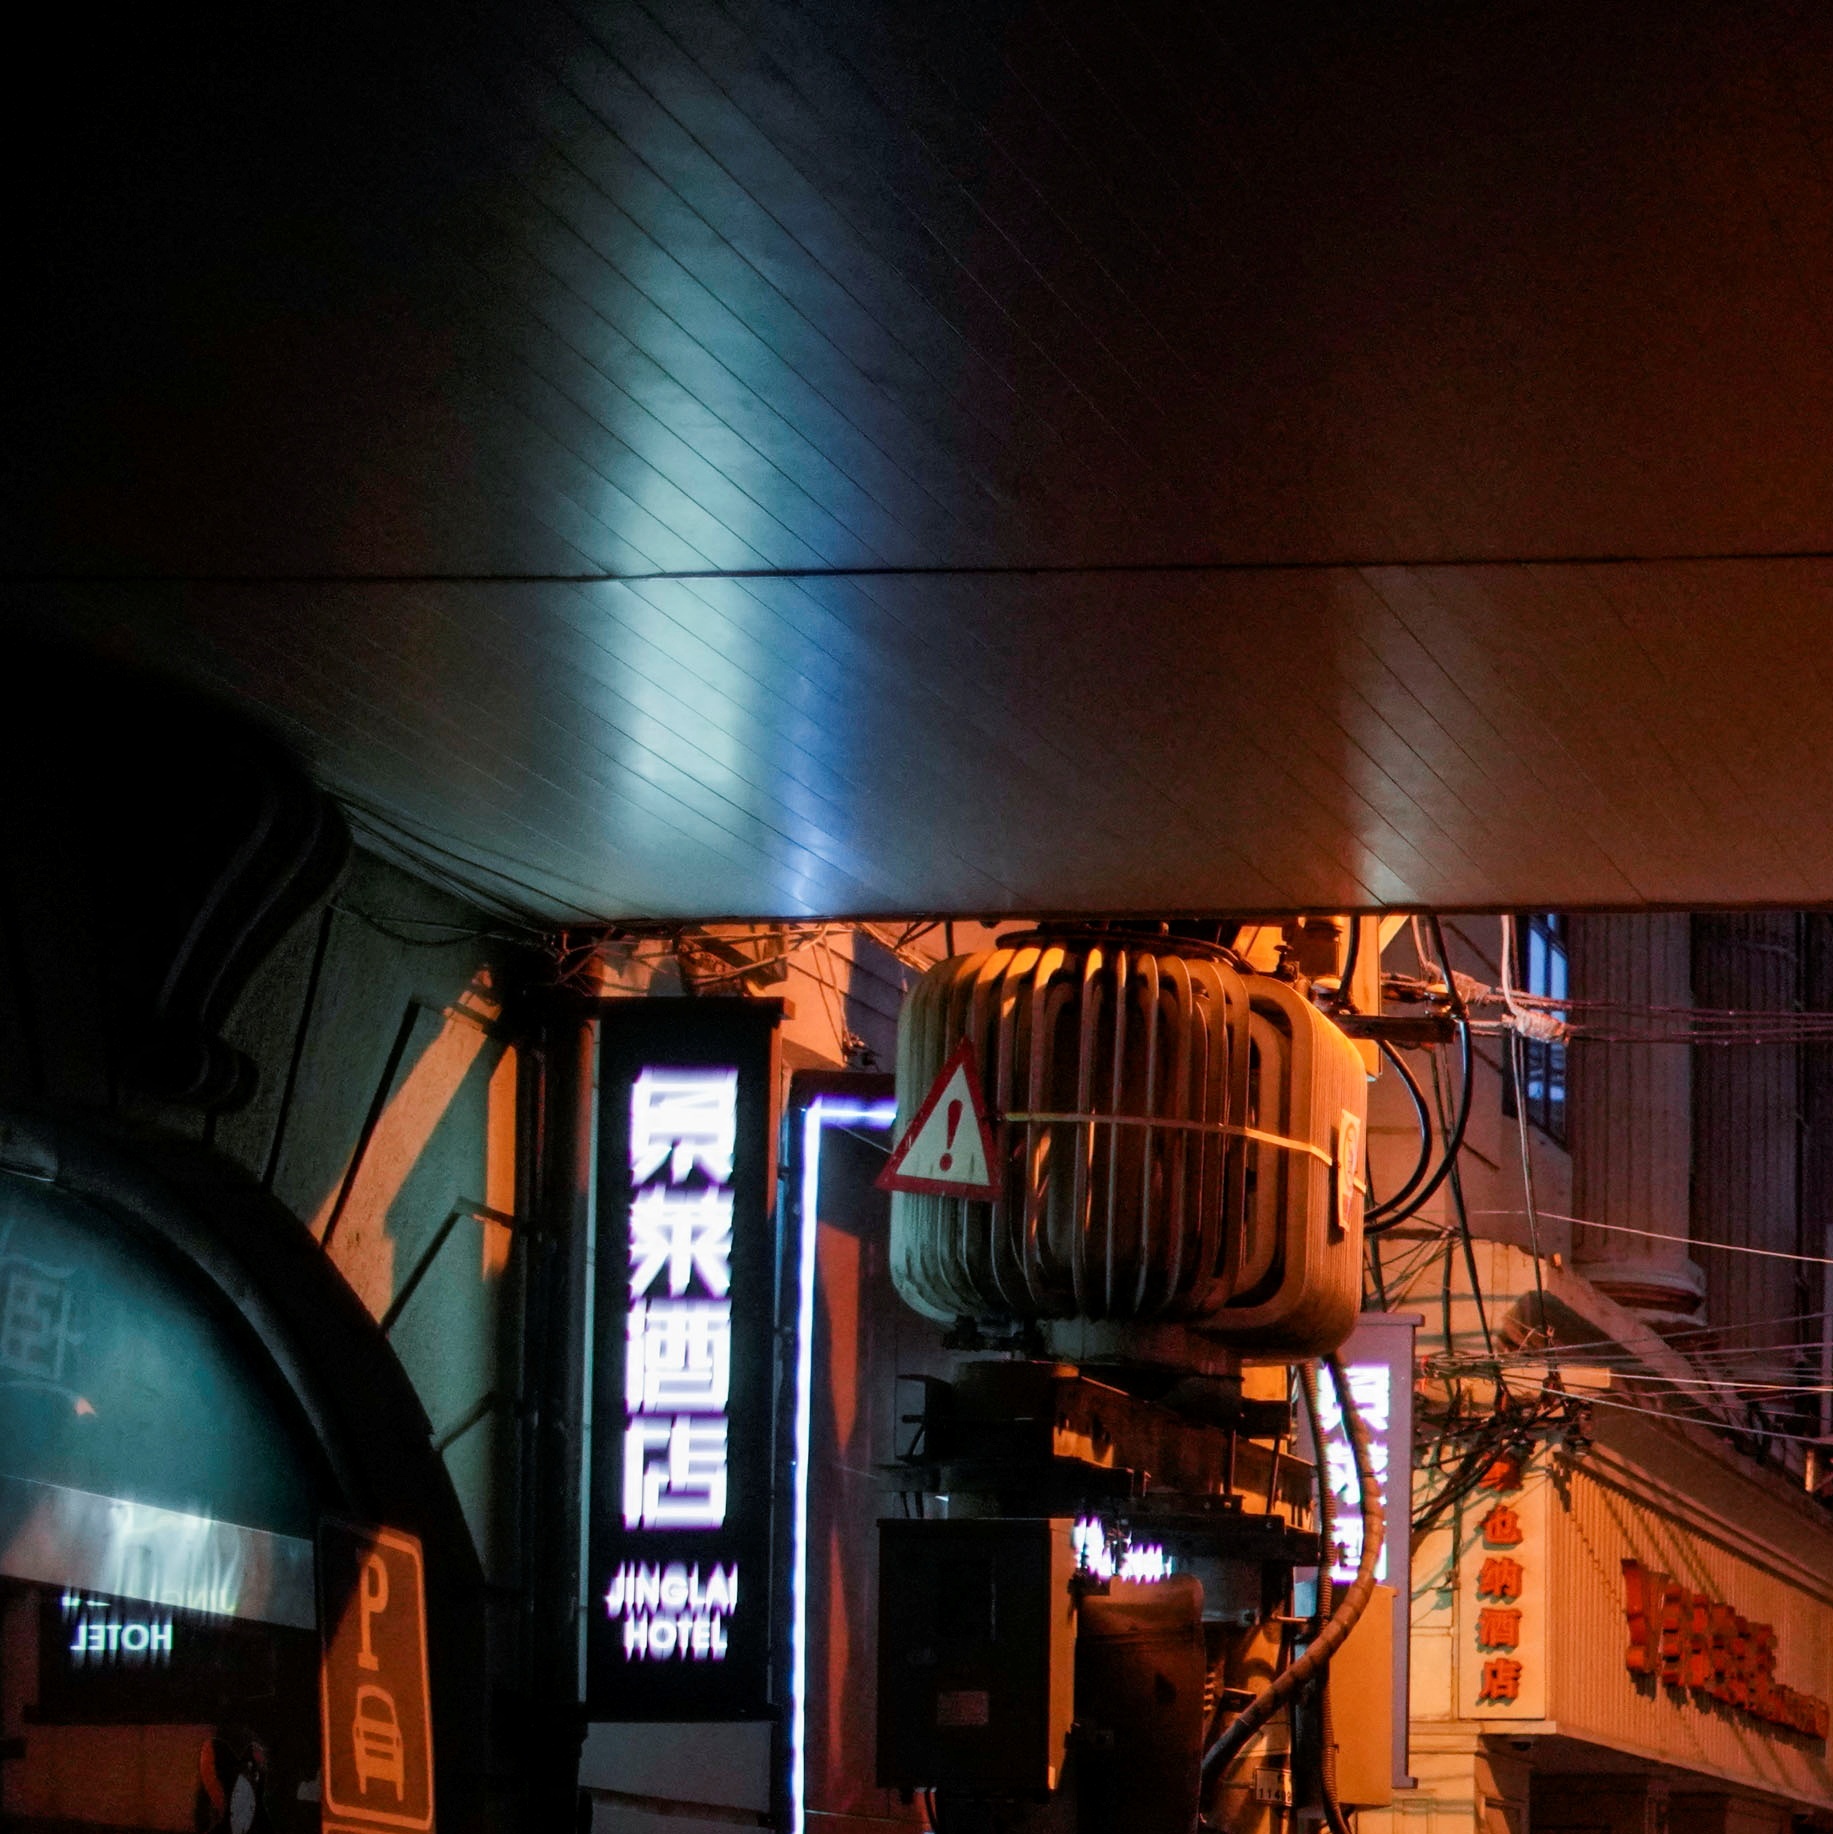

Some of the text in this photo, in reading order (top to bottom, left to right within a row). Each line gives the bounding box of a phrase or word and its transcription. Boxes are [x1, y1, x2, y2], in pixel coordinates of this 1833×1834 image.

[623, 1066, 738, 1530] 景莱酒店
[358, 1553, 389, 1671] P
[604, 1561, 738, 1617] JINGLAI
[623, 1612, 728, 1661] HOTEL
